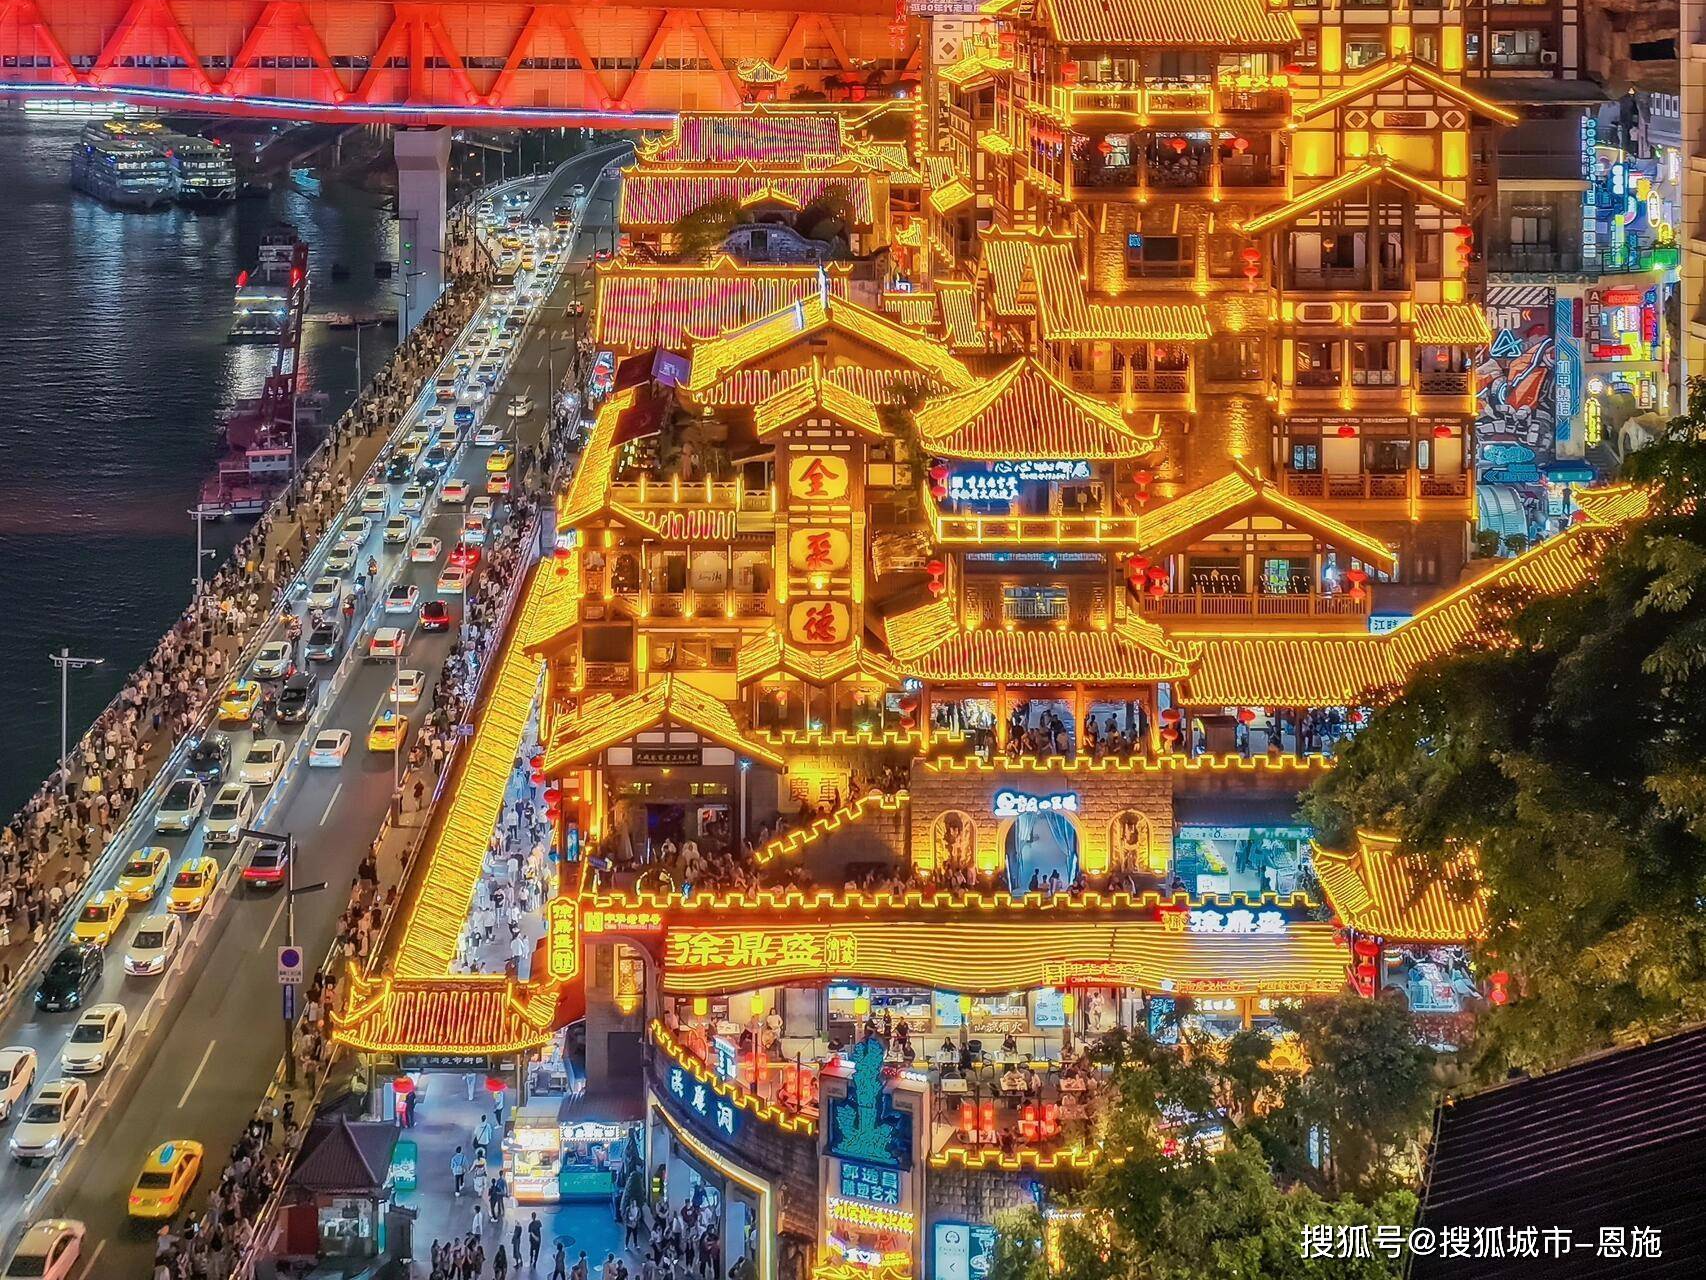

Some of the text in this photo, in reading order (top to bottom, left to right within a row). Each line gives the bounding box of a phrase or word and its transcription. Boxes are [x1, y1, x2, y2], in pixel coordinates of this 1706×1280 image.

[673, 932, 822, 967] 徐鼎盛
[842, 1180, 898, 1205] 雕塑艺术
